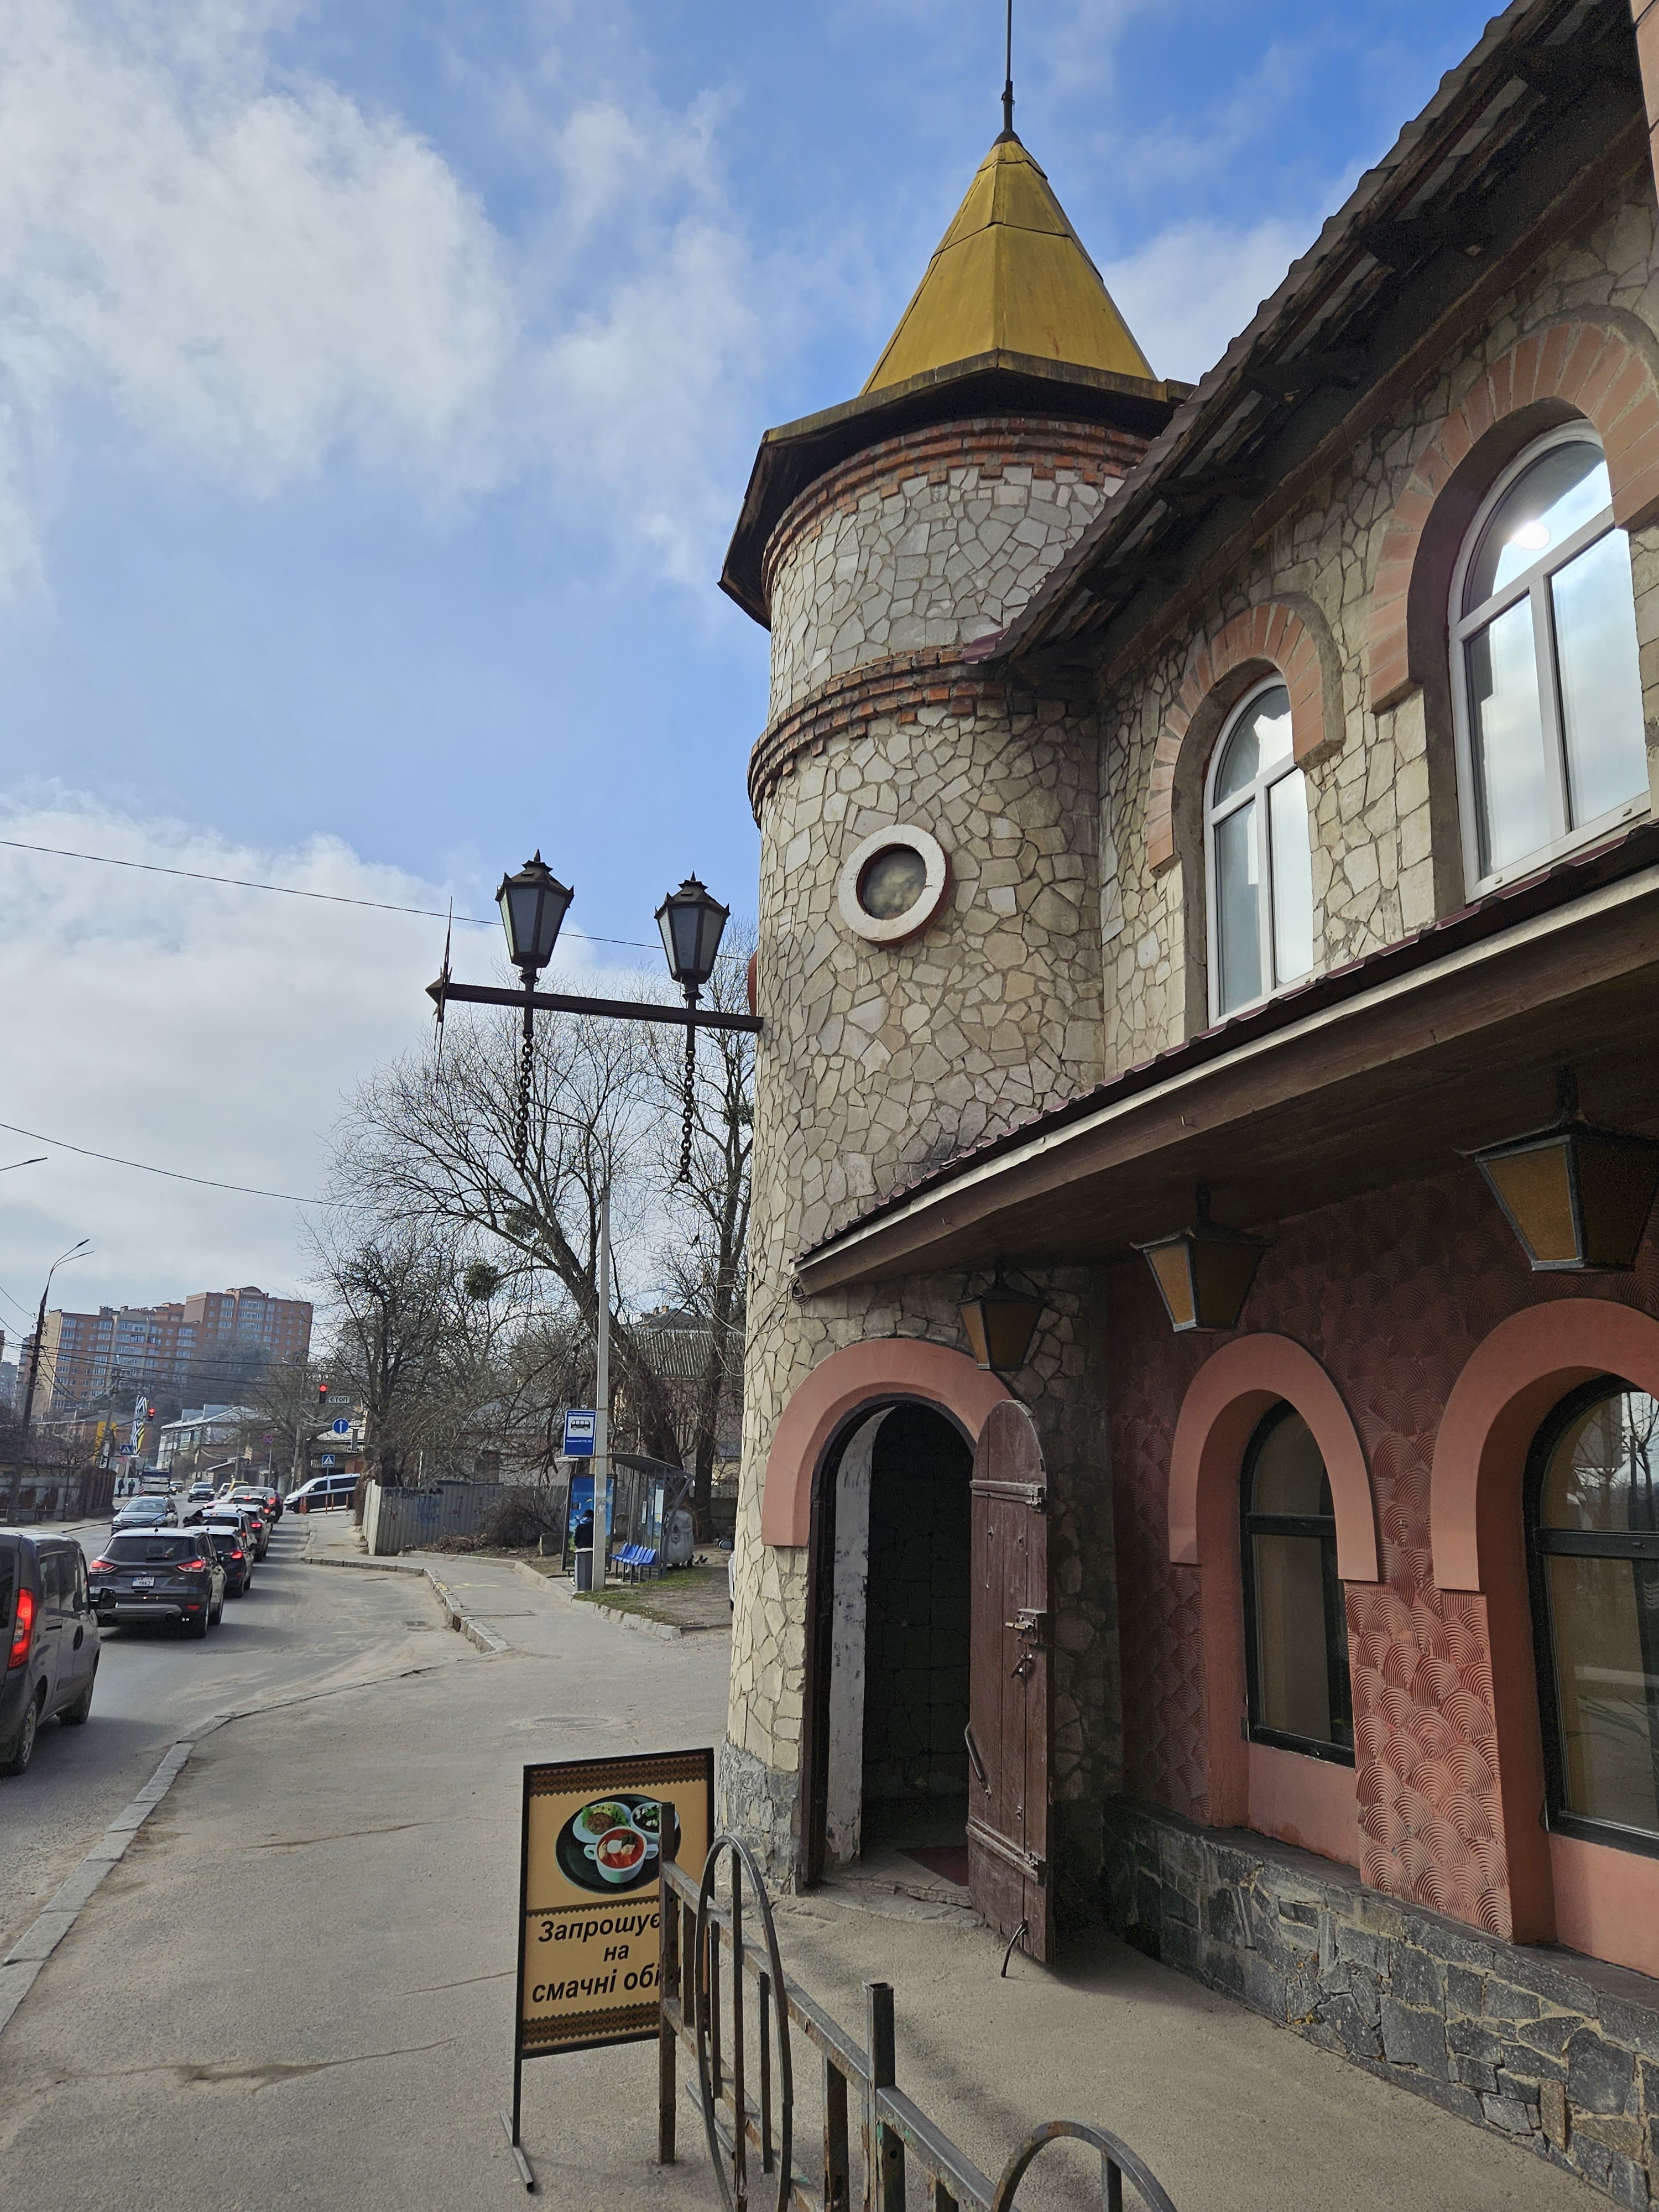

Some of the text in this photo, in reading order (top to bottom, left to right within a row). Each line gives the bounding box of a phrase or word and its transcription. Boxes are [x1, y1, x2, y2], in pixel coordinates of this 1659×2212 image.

[538, 1913, 660, 1943] Запрошує
[603, 1944, 629, 1962] на
[532, 1963, 660, 2003] смачні обі
